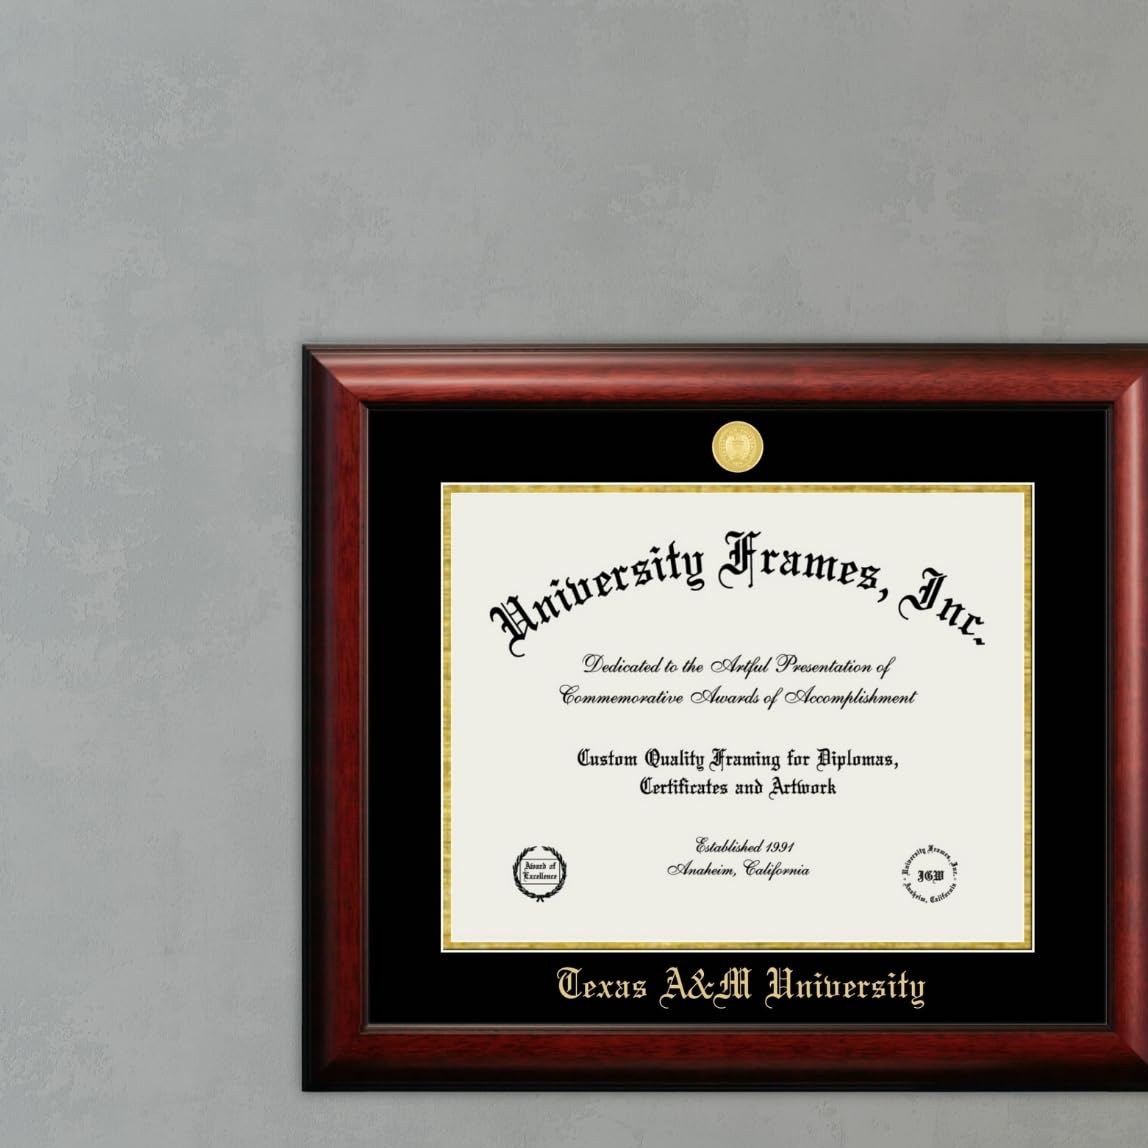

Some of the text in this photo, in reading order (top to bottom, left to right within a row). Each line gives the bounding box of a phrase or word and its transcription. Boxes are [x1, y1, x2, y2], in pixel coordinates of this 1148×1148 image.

[489, 530, 986, 657] University Frames, Inc.
[582, 653, 897, 680] Dedicated to the Artful Presentation of
[559, 684, 918, 711] Commemorative Awards of Accomplishment
[577, 748, 899, 772] Custom Quality Framing for Diplomas,
[640, 776, 837, 801] Certificates and Artwork
[696, 836, 795, 854] Established 1991
[522, 871, 558, 882] Excellence
[523, 861, 558, 871] Award of
[667, 859, 810, 881] Anaheim, California
[557, 966, 926, 1010] Texas A&M University
